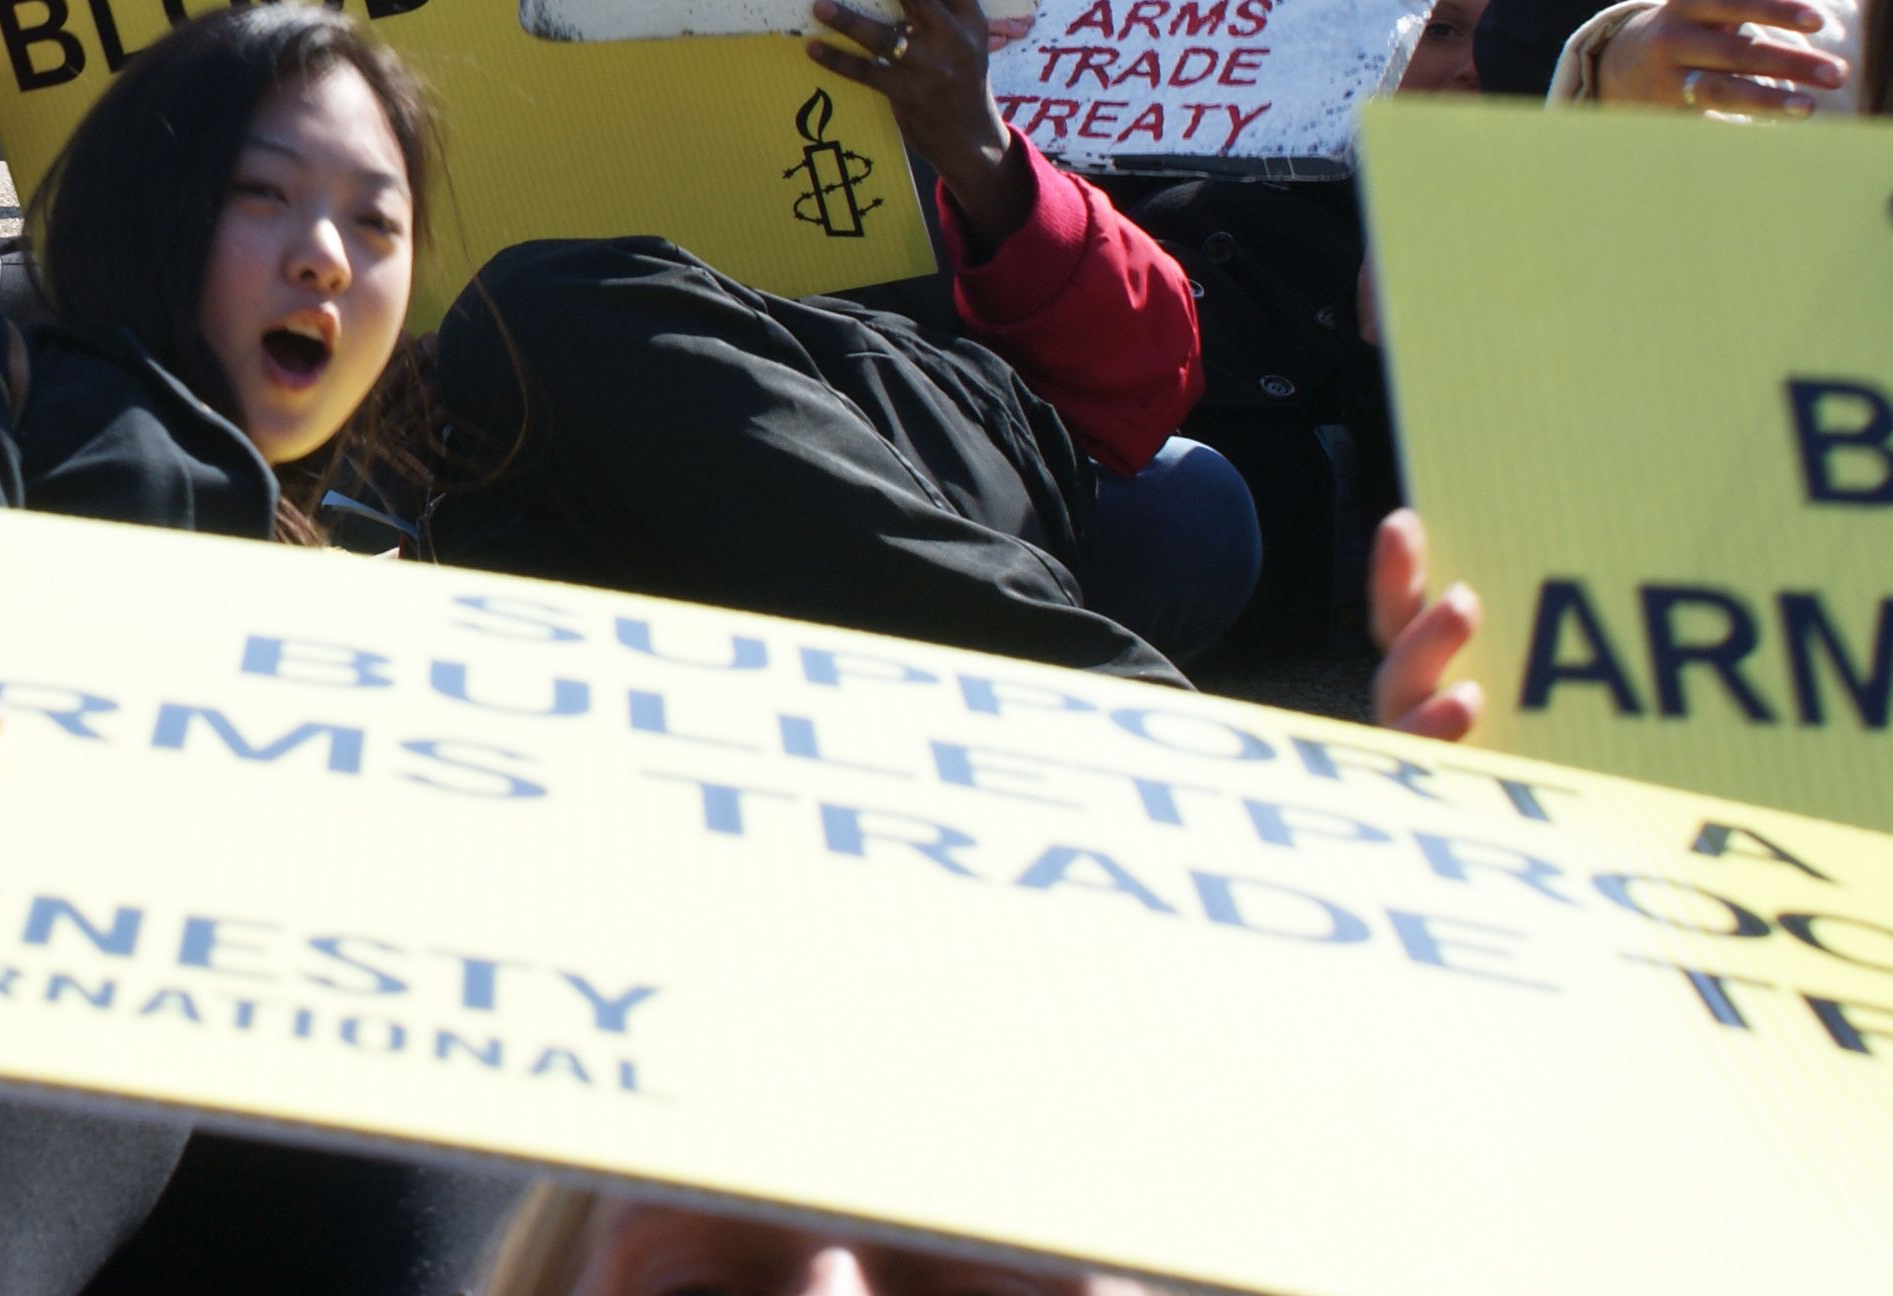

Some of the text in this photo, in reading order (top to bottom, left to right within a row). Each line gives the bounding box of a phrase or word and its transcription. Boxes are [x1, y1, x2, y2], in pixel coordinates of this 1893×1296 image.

[994, 95, 1271, 156] TREATY
[1038, 46, 1271, 90] TRADE
[450, 591, 1847, 889] SUPPORT A
[637, 767, 1561, 995] TRADE
